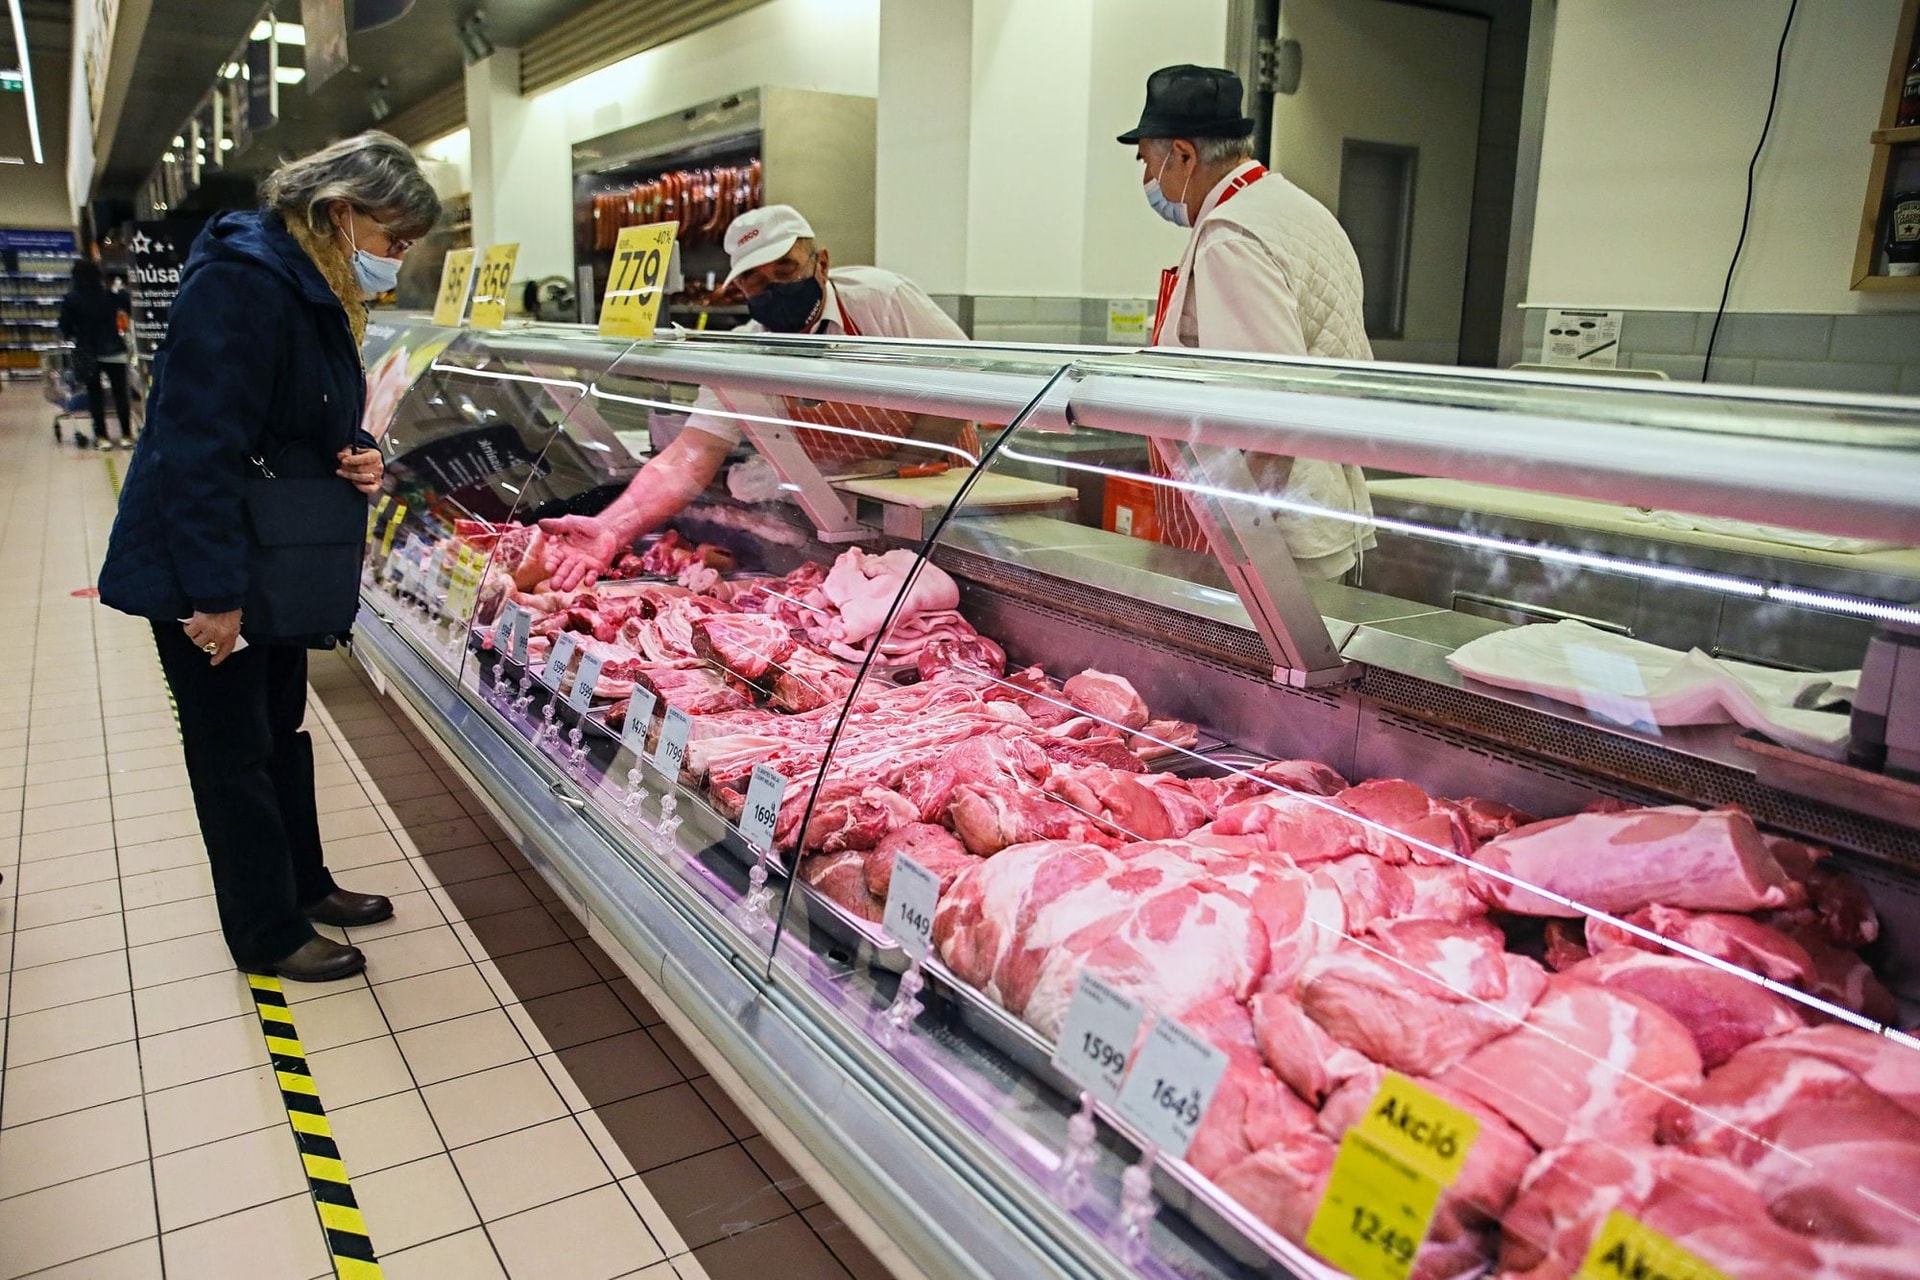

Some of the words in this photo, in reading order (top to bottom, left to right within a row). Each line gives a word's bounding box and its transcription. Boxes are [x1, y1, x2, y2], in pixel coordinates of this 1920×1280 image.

[610, 248, 661, 307] 779
[553, 660, 565, 675] 1599
[579, 682, 592, 698] 1599
[631, 718, 647, 738] 1479
[666, 741, 683, 763] 1799
[754, 804, 776, 828] 1699
[901, 903, 930, 935] 1449
[1082, 1032, 1126, 1075] 1599
[1152, 1078, 1201, 1126] 1649
[1376, 1097, 1458, 1159] Akció
[1352, 1205, 1415, 1264] 1249
